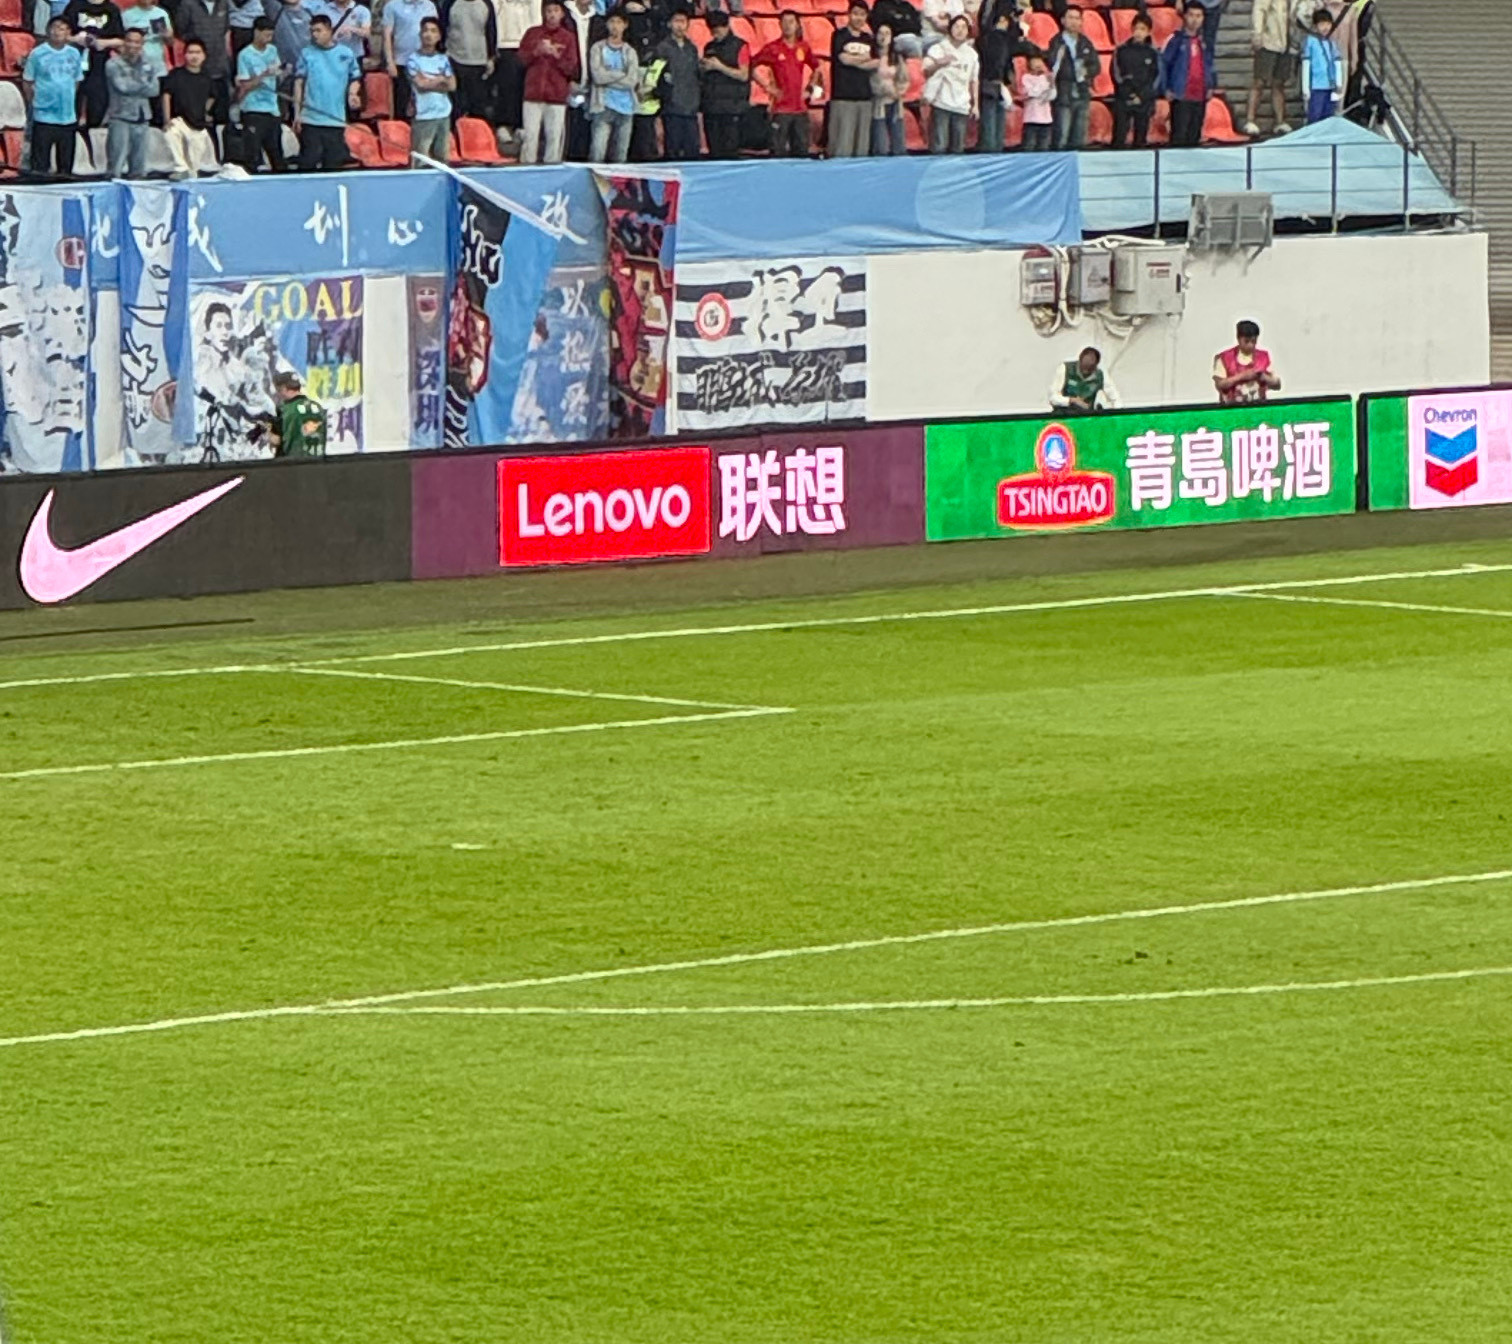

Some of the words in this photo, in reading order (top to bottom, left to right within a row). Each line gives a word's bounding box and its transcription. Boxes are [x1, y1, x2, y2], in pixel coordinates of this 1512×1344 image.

[253, 278, 364, 322] GOAL
[1423, 407, 1477, 424] Chevron
[1125, 421, 1331, 511] 青岛啤酒
[517, 481, 692, 540] Lenovo
[717, 445, 846, 542] 联想
[1003, 482, 1108, 518] TSINGTAO
